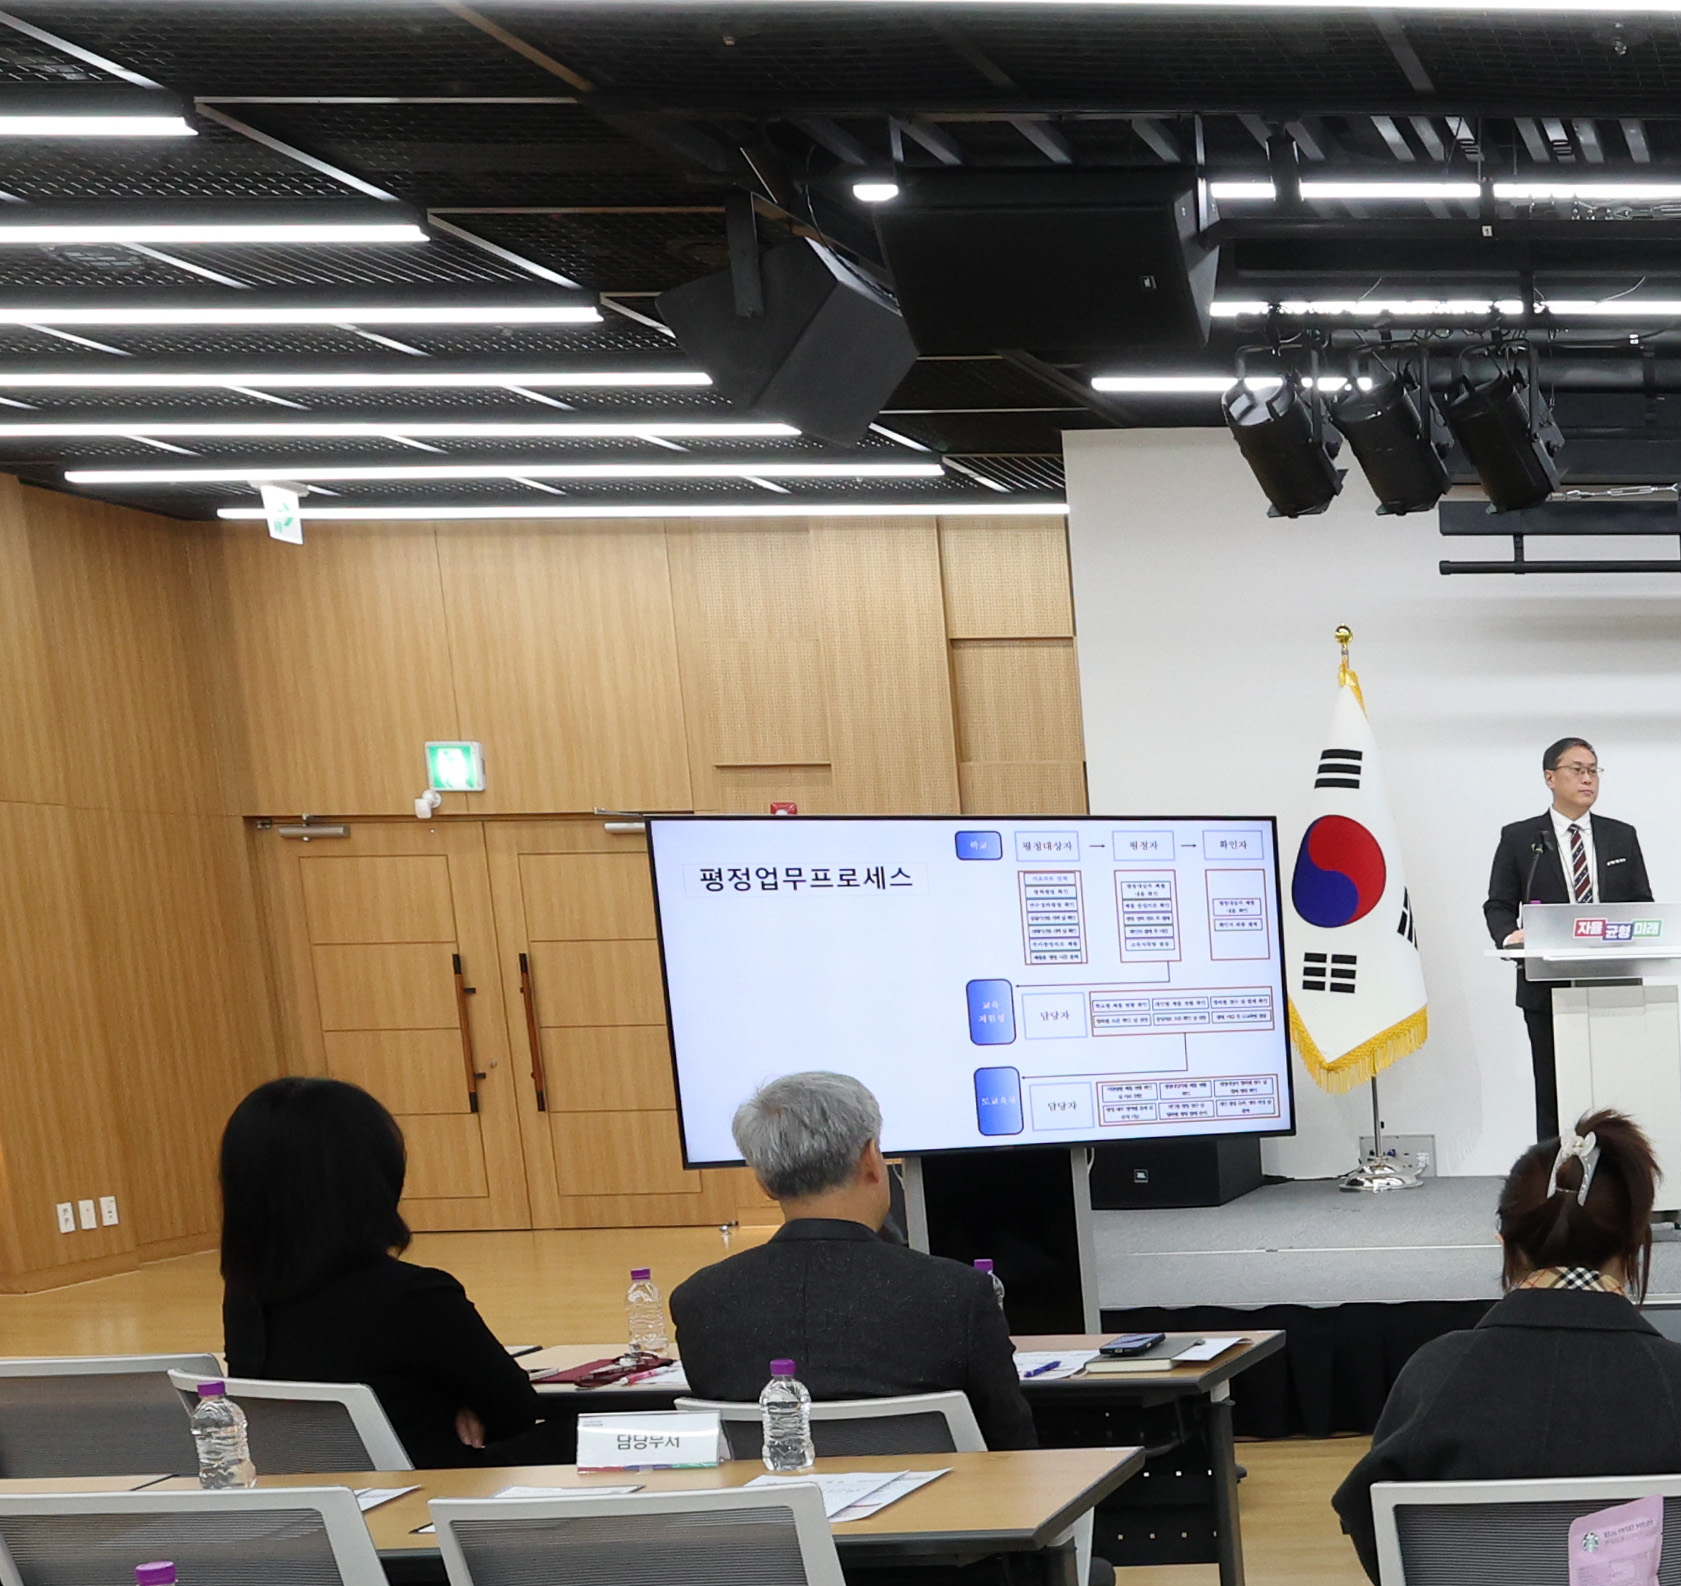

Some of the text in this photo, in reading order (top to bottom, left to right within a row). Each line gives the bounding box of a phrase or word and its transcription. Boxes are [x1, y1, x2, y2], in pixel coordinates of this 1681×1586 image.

[1022, 840, 1073, 852] 평정대상자
[1129, 840, 1159, 851] 평정자
[1219, 839, 1248, 851] 확인자
[699, 865, 913, 893] 평정업무프로세스
[1577, 920, 1660, 939] 자율 균형 미래
[1040, 1010, 1070, 1021] 담당자
[1048, 1100, 1078, 1112] 담당자
[617, 1433, 681, 1450] 담당부서
